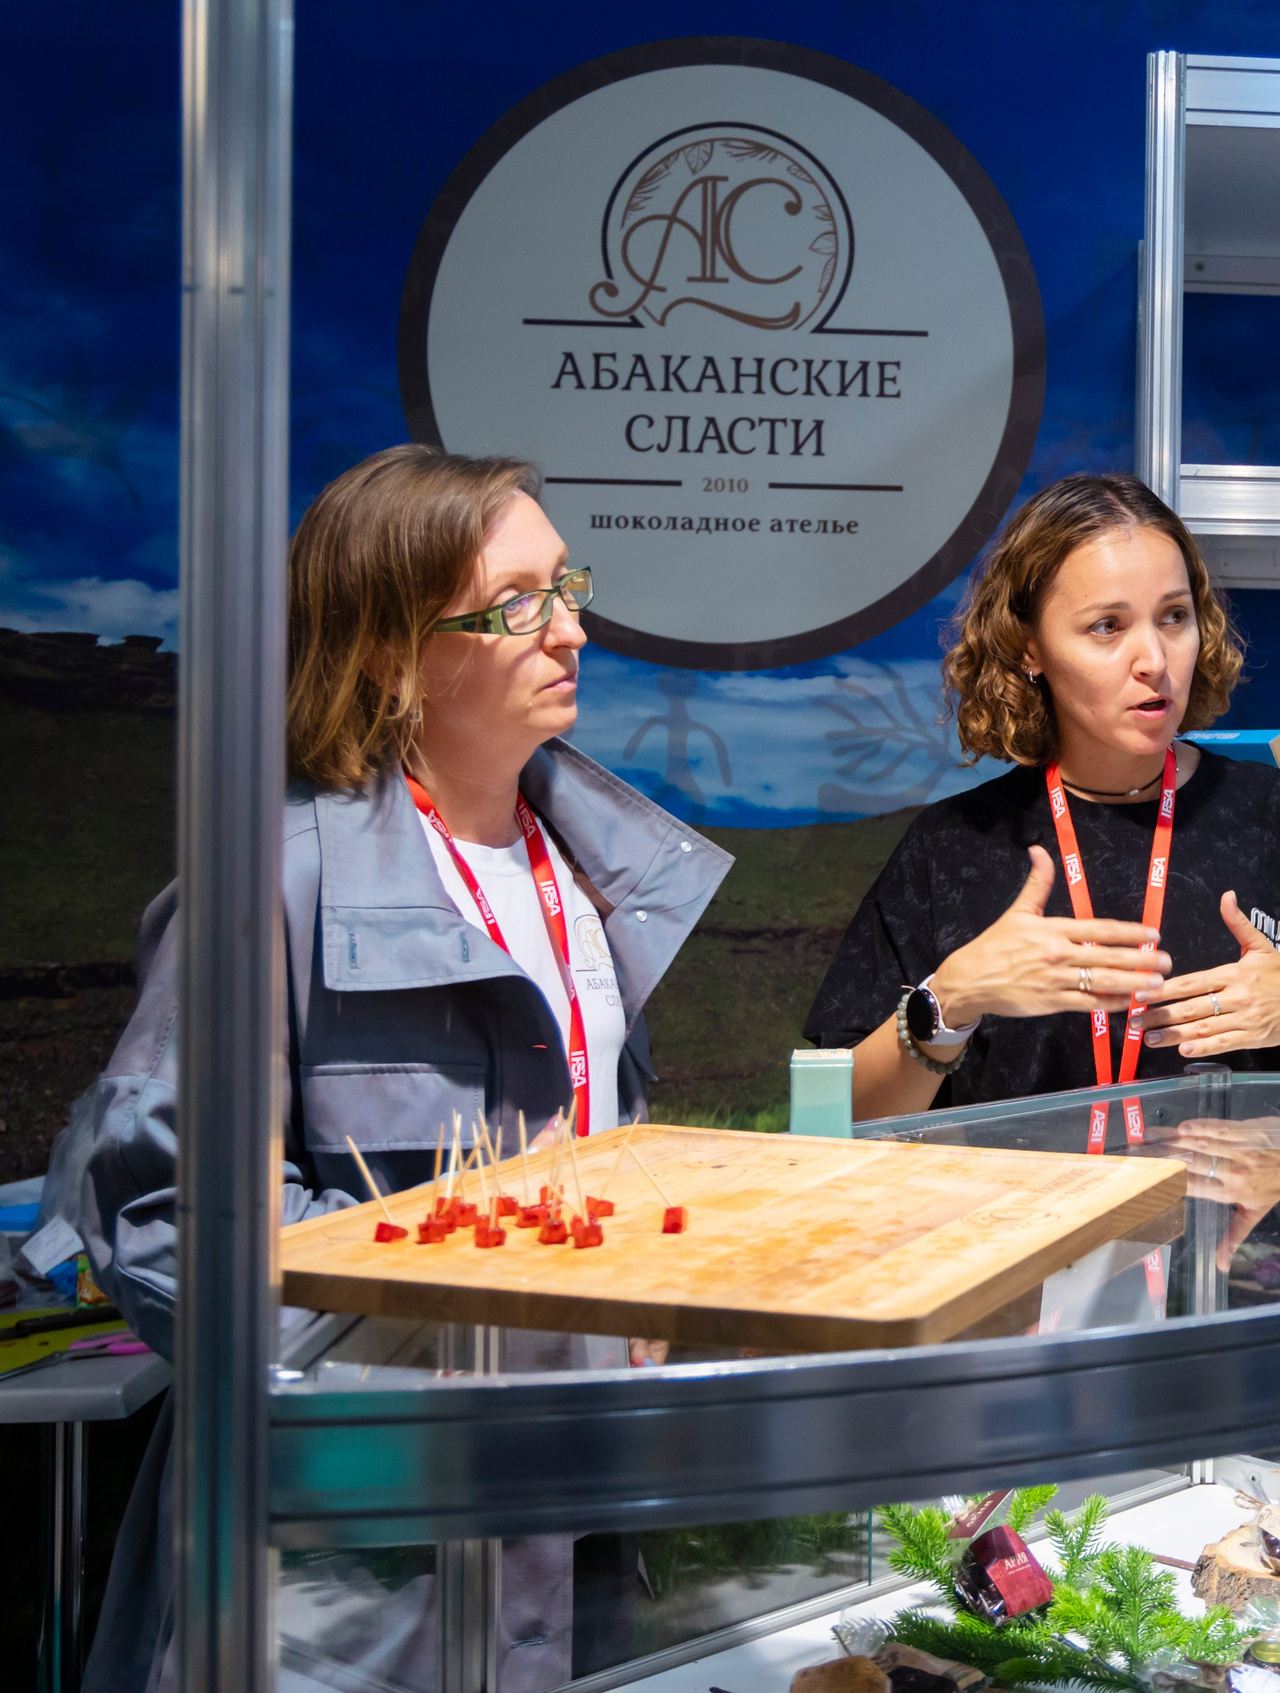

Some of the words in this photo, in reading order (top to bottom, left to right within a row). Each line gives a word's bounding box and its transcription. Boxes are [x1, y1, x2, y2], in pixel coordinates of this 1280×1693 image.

[550, 351, 903, 399] АБАКАНСКИЕ
[624, 414, 826, 457] СЛАСТИ
[701, 477, 749, 493] 2010
[590, 511, 761, 533] шоколадное
[769, 515, 860, 535] ателье
[1051, 786, 1065, 819] IFSA
[1161, 789, 1174, 818] IFSA
[518, 803, 537, 839] IFSA
[1065, 853, 1082, 885] IFSA
[1150, 857, 1166, 887] IFSA
[476, 888, 496, 925] IFSA
[540, 880, 561, 917] IFSA
[587, 978, 617, 990] АБАКА
[571, 1050, 587, 1088] IFSA
[1004, 1551, 1029, 1570] АРИЯ
